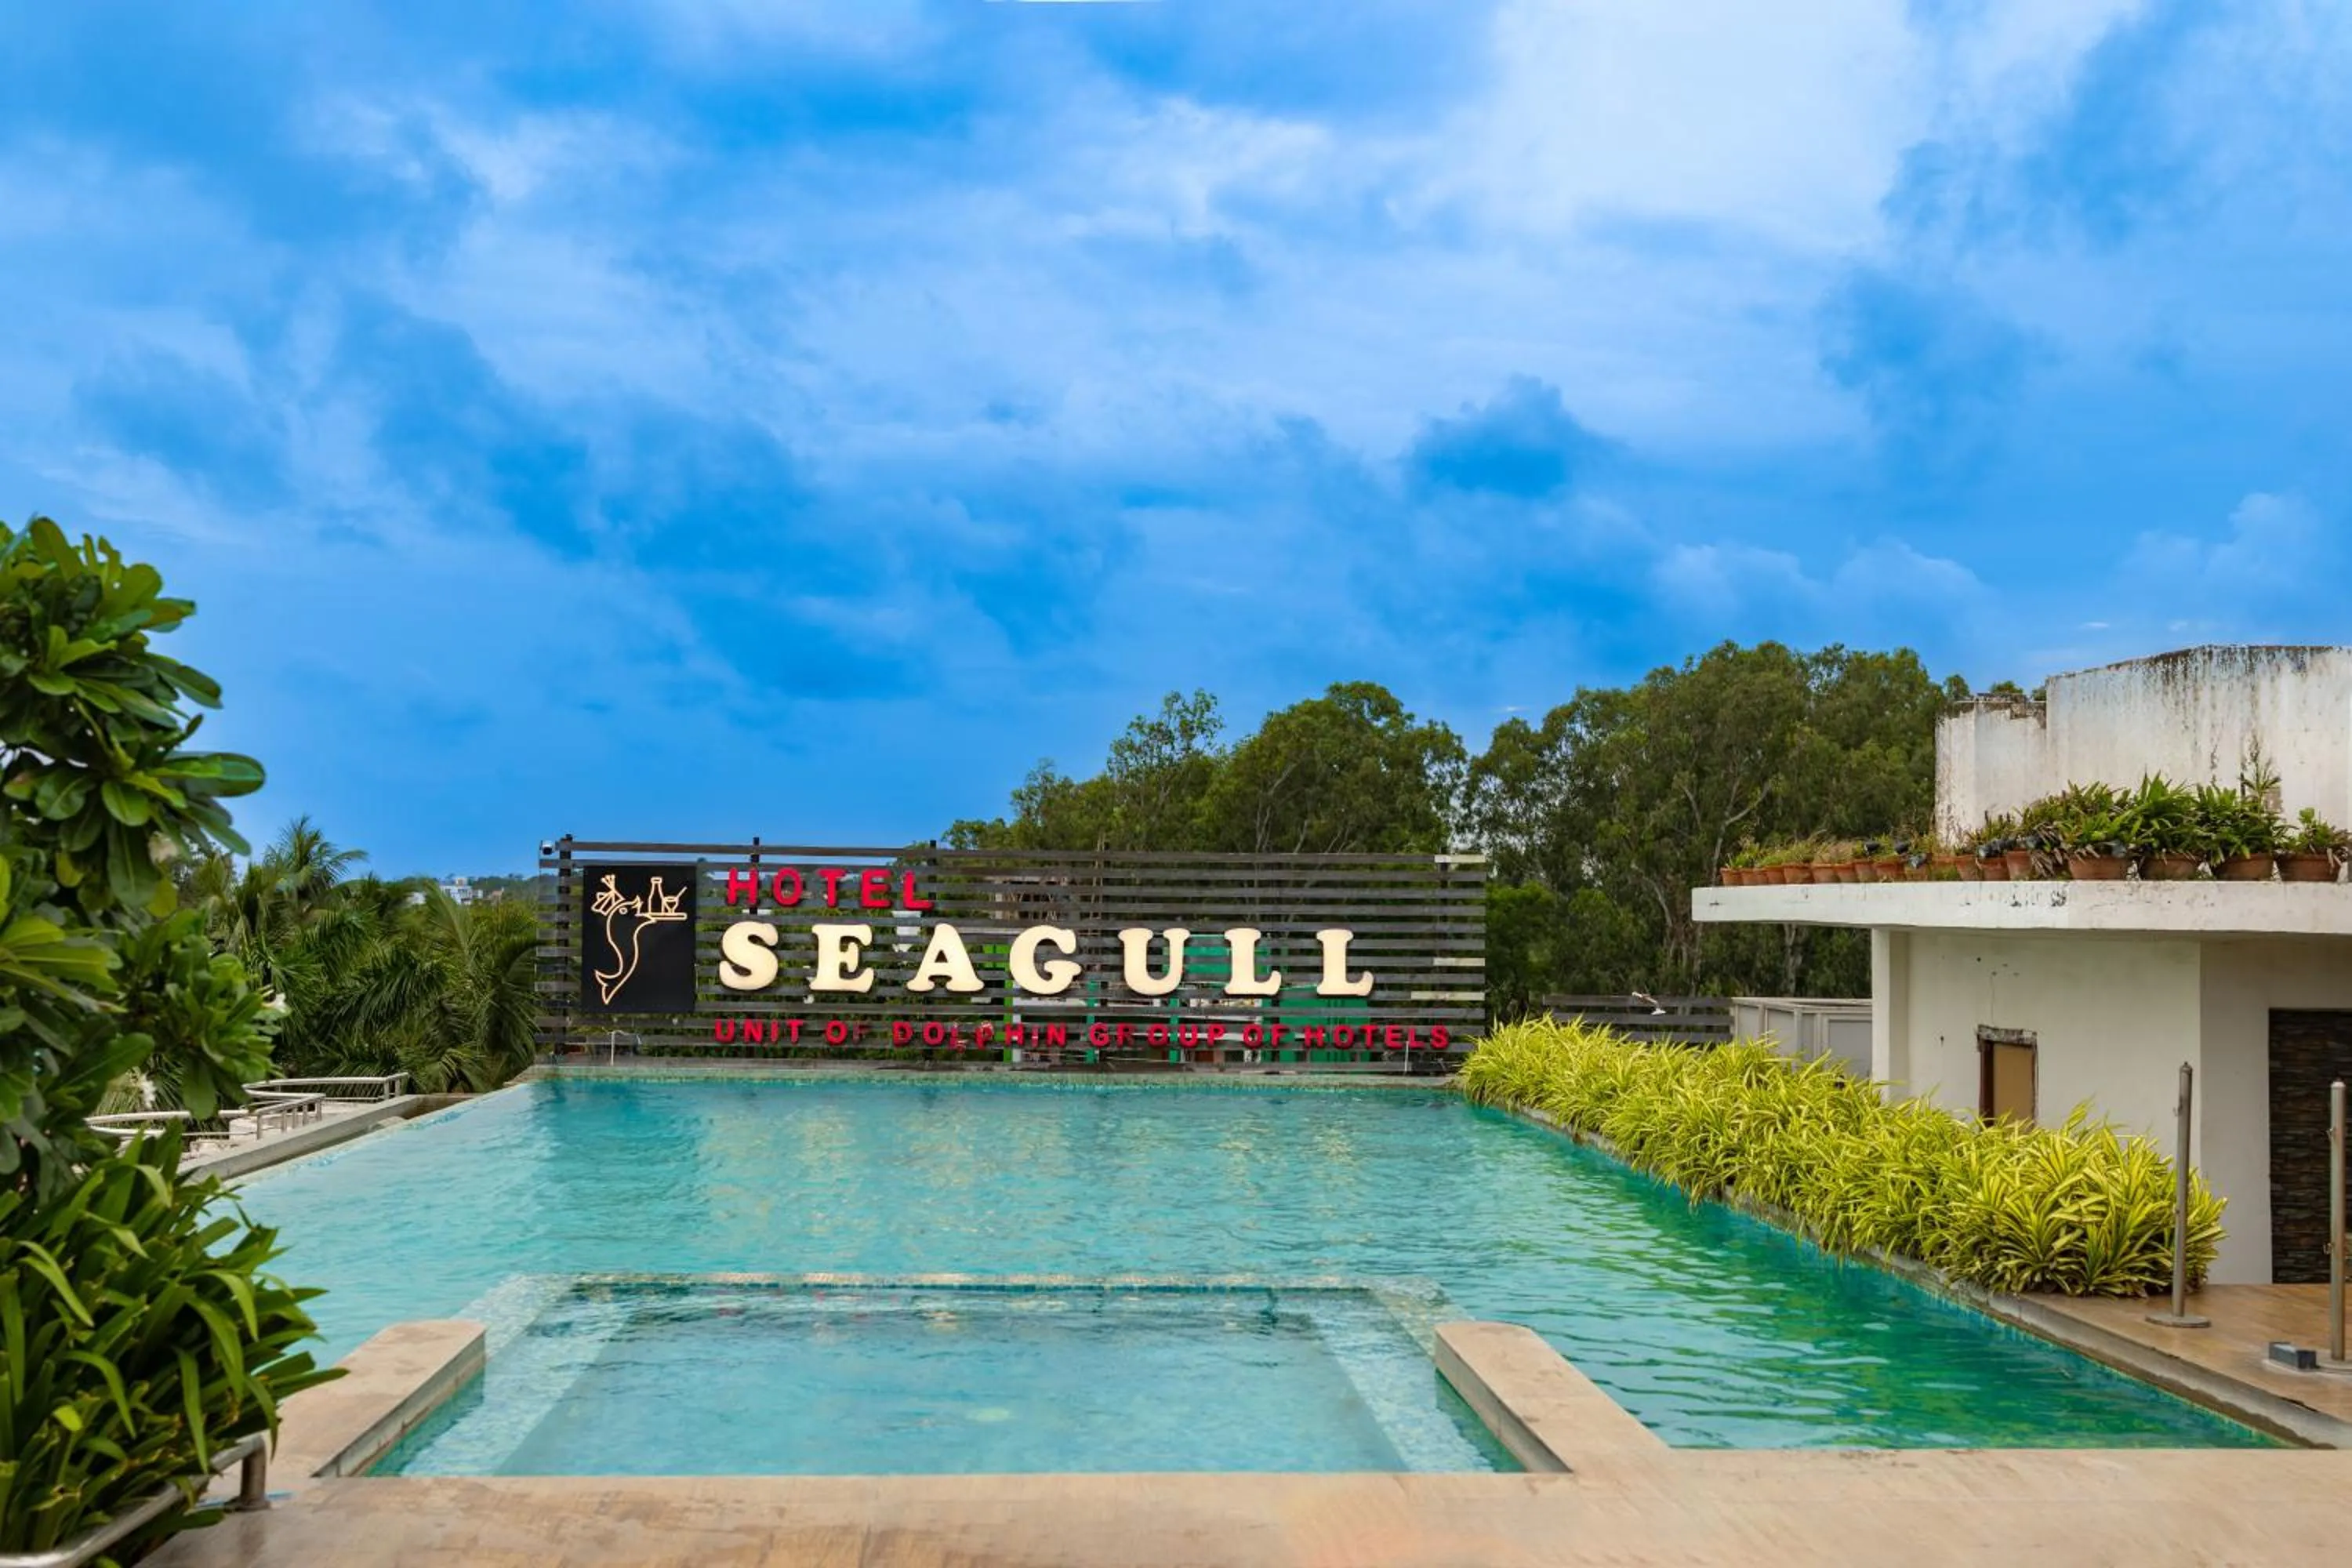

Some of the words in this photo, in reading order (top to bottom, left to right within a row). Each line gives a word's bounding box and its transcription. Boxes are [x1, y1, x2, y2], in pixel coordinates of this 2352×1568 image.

[727, 867, 935, 910] HOTEL
[719, 920, 1374, 996] SEAGULL
[713, 1019, 804, 1046] UNIT
[825, 1020, 869, 1045] OF
[892, 1021, 1067, 1051] DOLPHIN
[1087, 1022, 1225, 1049] GROUP
[1243, 1023, 1290, 1048] OF
[1304, 1024, 1450, 1049] HOTELS
